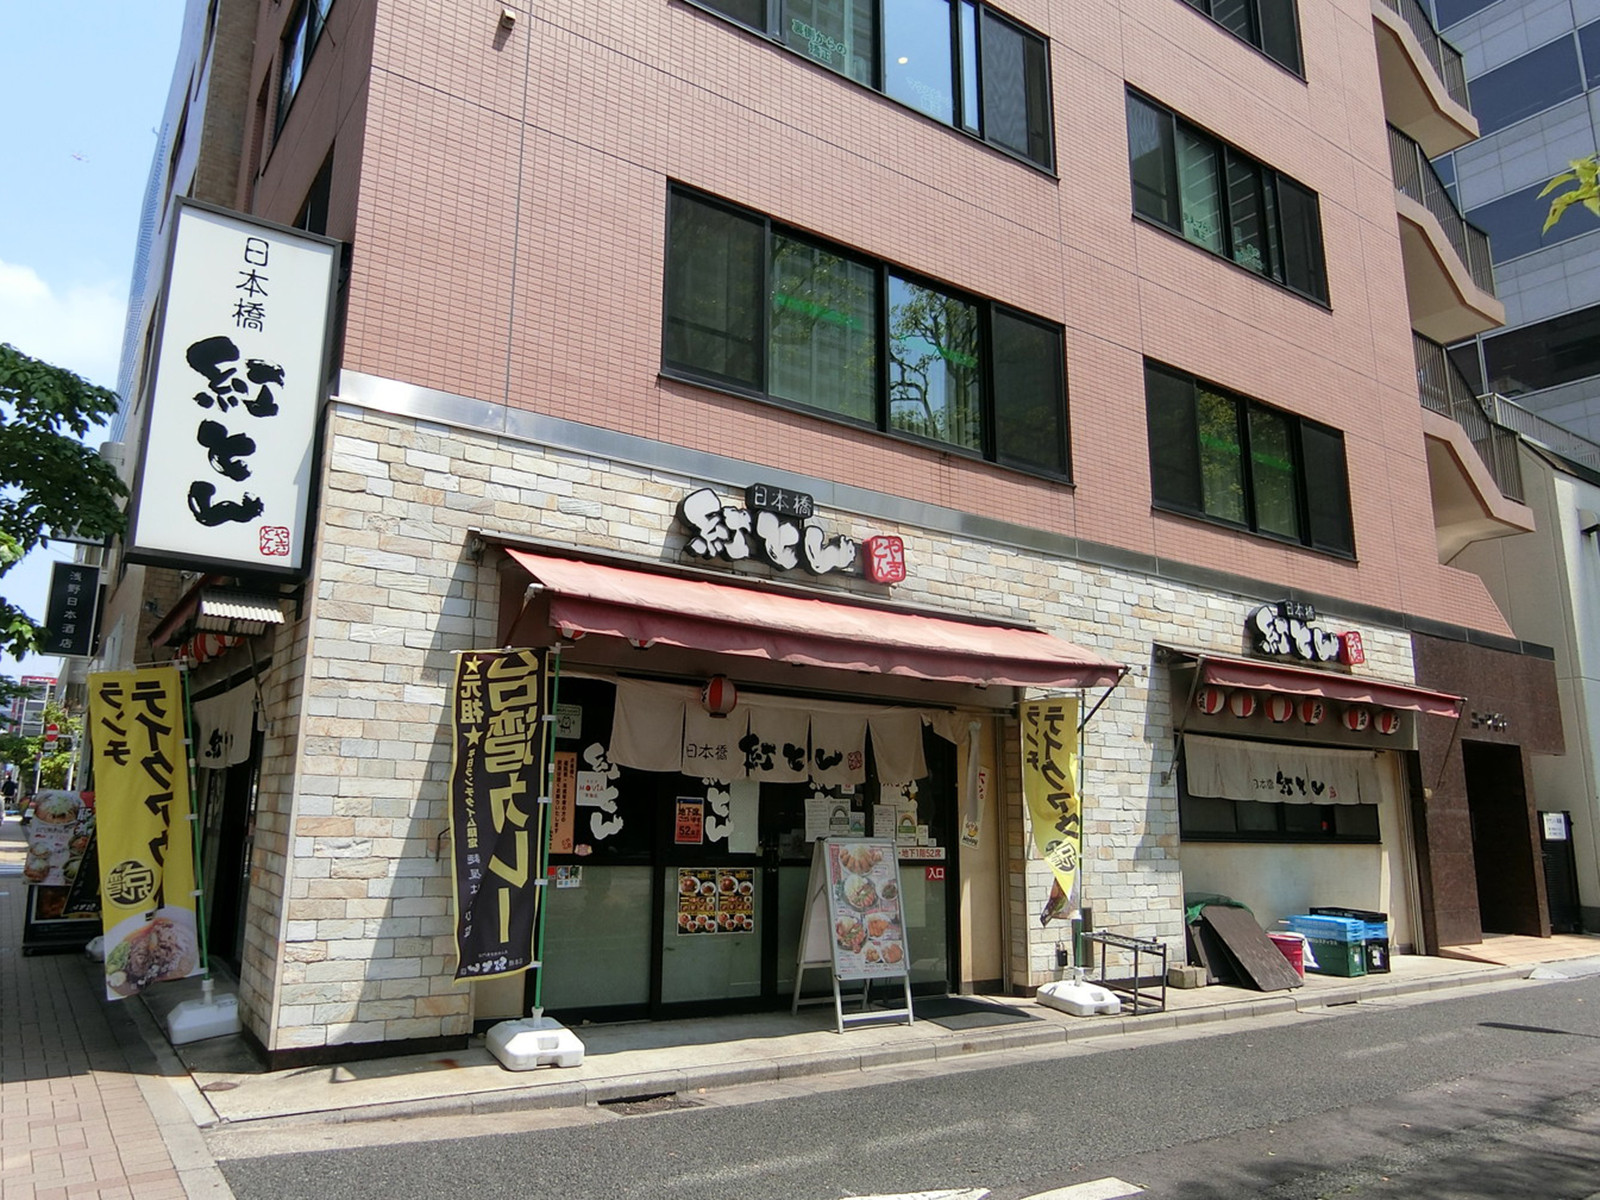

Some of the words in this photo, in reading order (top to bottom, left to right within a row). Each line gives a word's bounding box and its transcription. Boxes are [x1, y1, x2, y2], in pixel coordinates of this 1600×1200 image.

[233, 236, 270, 333] 日本橋
[186, 336, 285, 526] 紅とん
[753, 485, 812, 517] 日本橋
[681, 487, 857, 574] 紅とん
[58, 570, 82, 648] 浅野日本酒店
[1286, 601, 1315, 619] 日本橋
[1255, 605, 1339, 661] 紅とん
[686, 743, 728, 761] 日本橋
[738, 733, 842, 772] 紅とん
[1276, 771, 1325, 796] 紅とん
[928, 868, 944, 879] 入口
